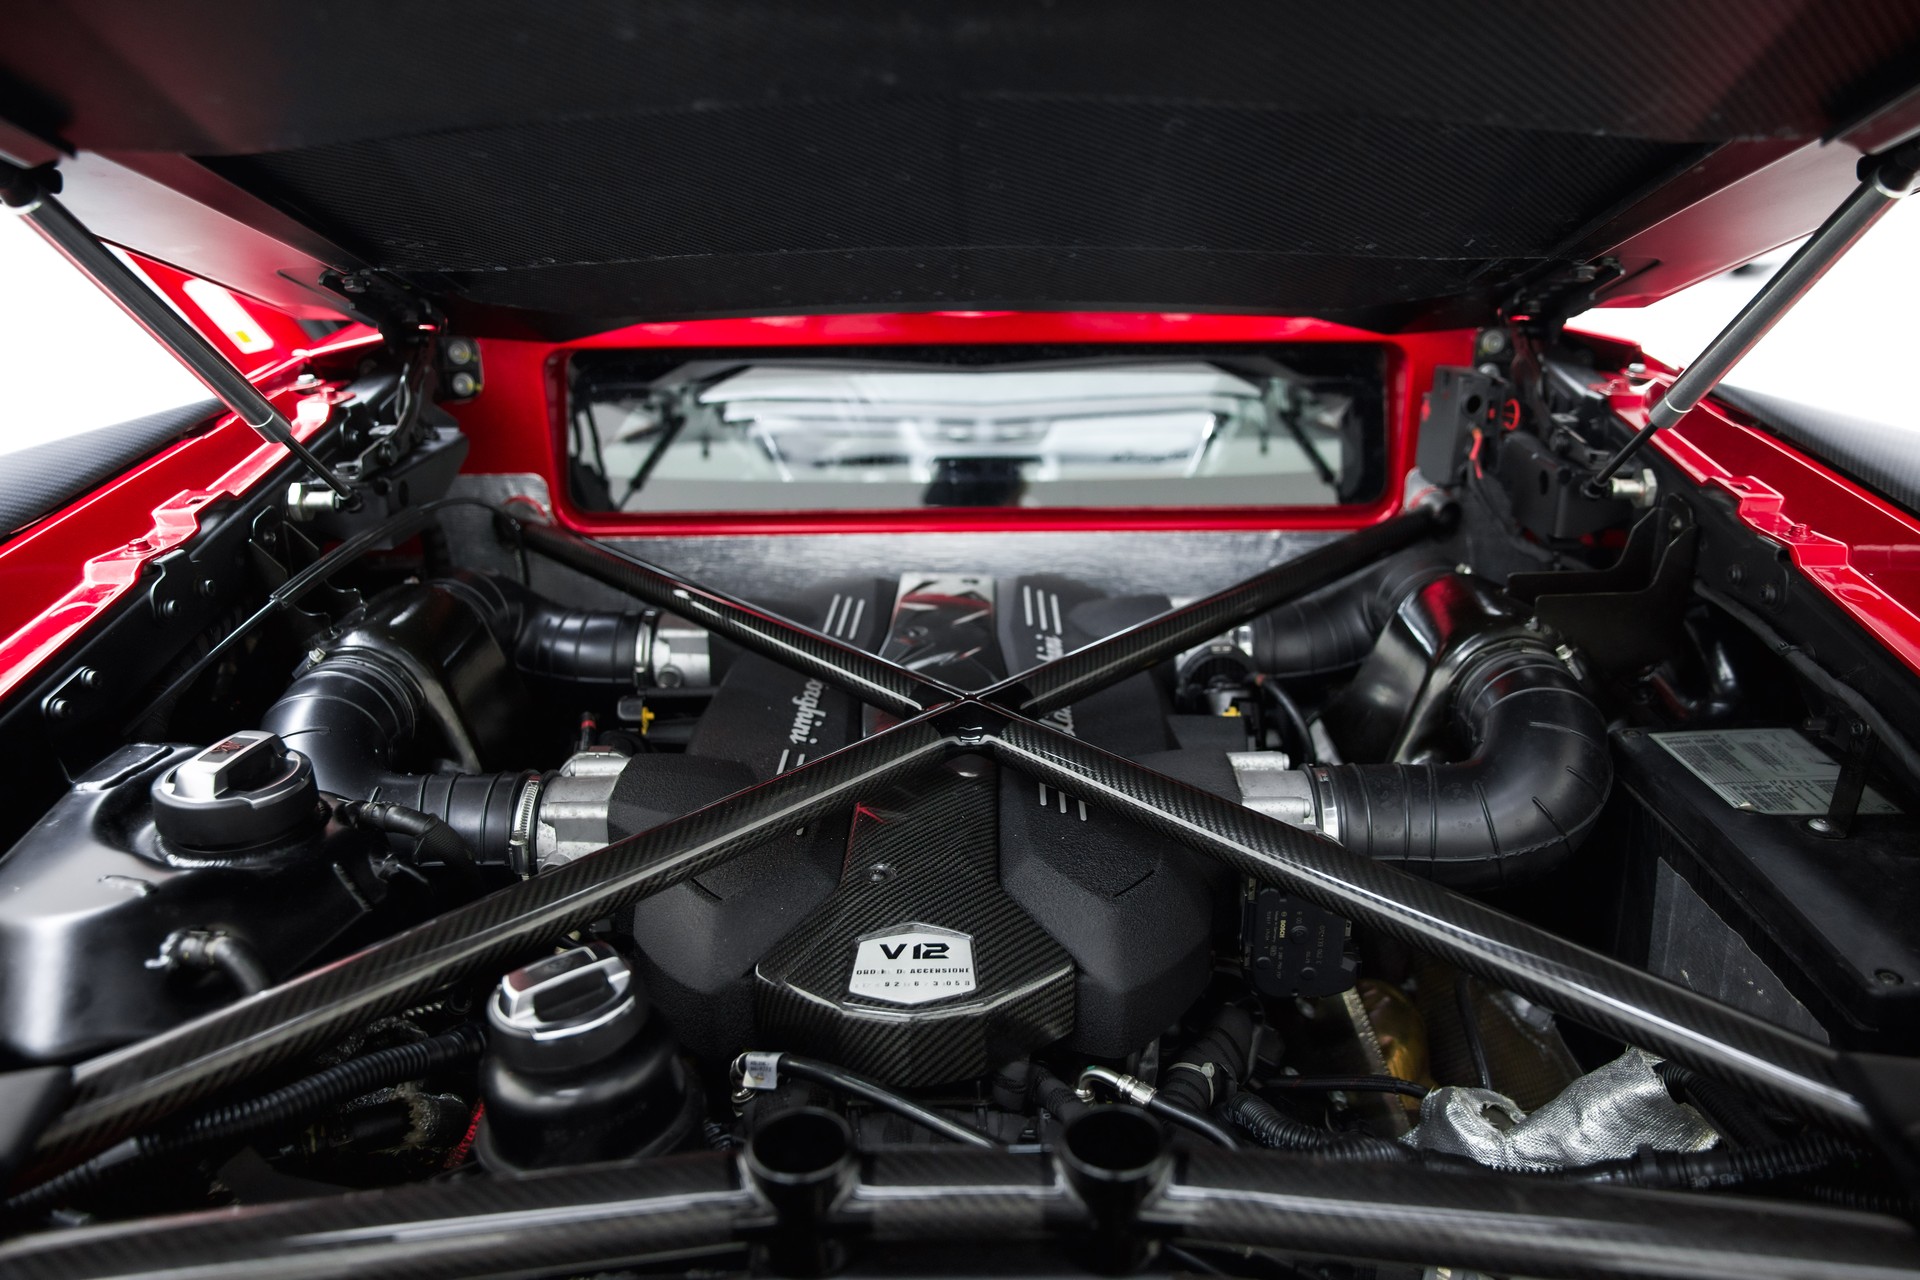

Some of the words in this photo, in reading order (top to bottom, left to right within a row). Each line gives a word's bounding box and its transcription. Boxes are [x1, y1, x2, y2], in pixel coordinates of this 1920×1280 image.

[789, 678, 827, 744] orghini
[879, 943, 950, 960] V12
[910, 967, 971, 975] ACCENSIONE
